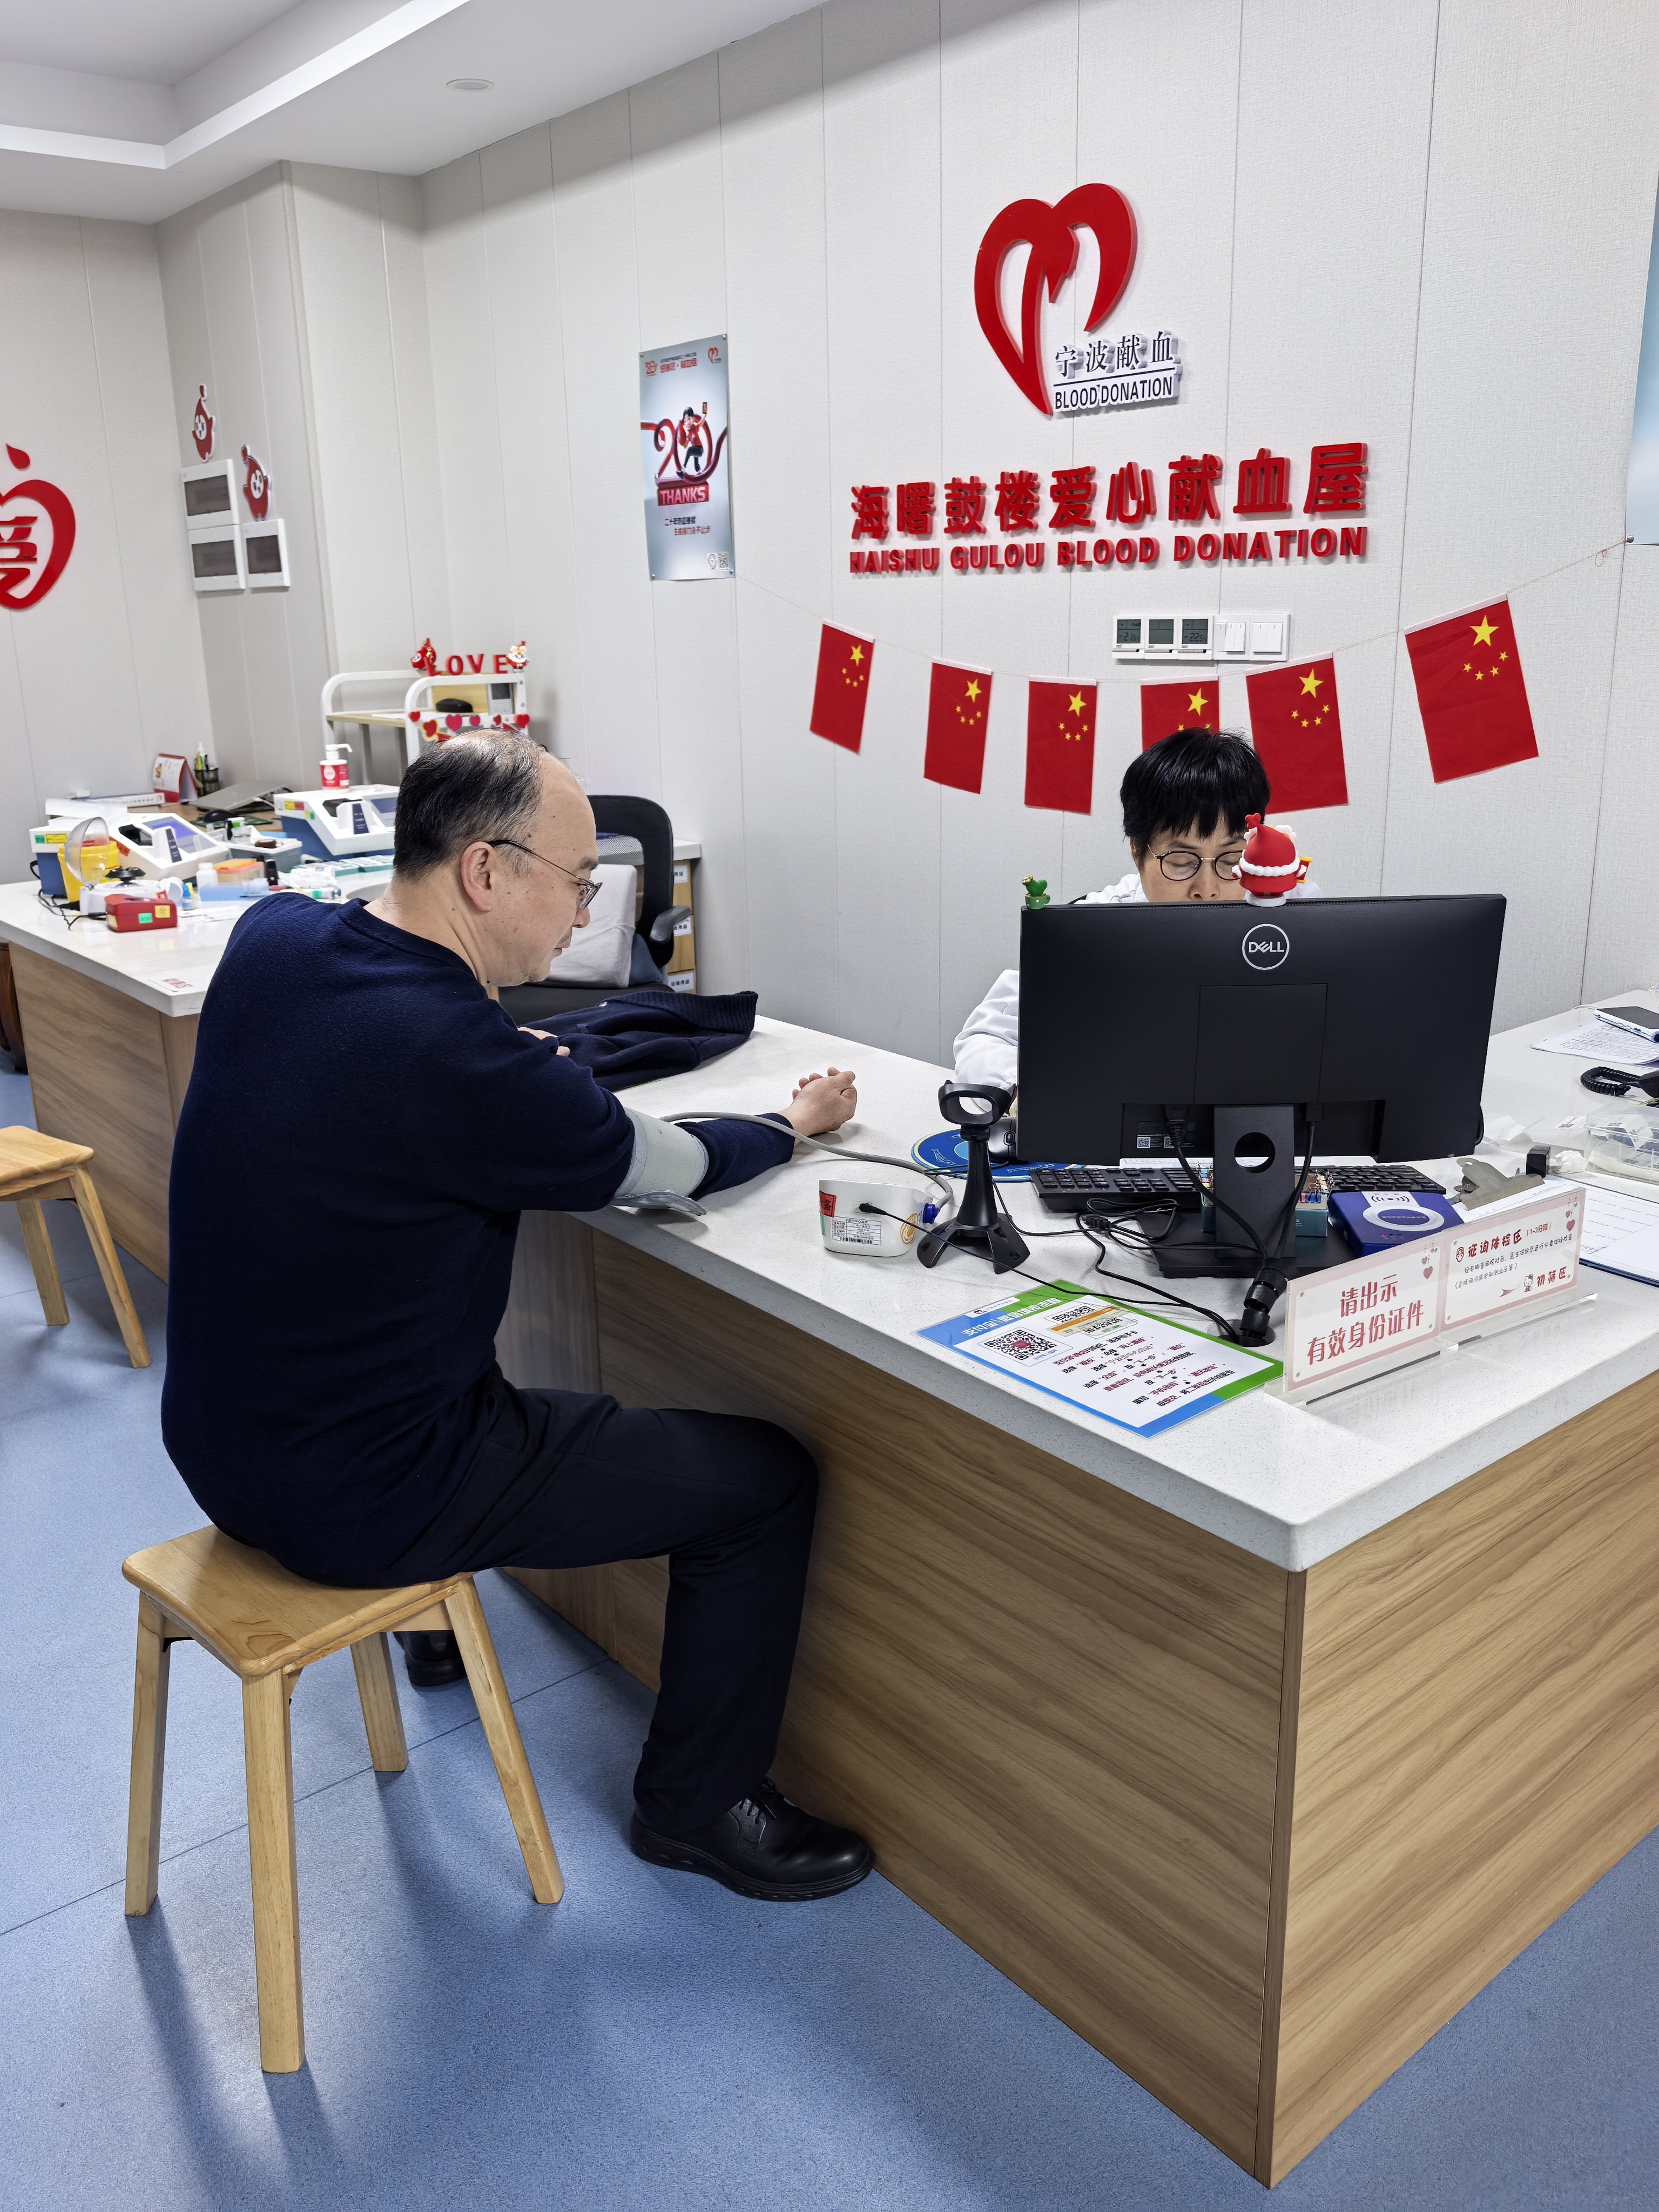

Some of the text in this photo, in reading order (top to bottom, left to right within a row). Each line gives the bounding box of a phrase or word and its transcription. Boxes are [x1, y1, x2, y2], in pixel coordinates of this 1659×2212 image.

[1055, 331, 1174, 377] 宁波献血
[1055, 376, 1172, 409] BLOOD DONATION
[660, 487, 706, 505] THANKS
[850, 442, 1367, 541] 海曙鼓楼爱心献血屋
[849, 527, 1367, 573] HAISHU GULOU BLOOD DONATION
[423, 653, 508, 677] LOVE
[1249, 941, 1284, 953] DELL
[1536, 1266, 1566, 1287] 初筛区
[1340, 1274, 1398, 1318] 请出示
[1307, 1300, 1424, 1365] 有效身份证件
